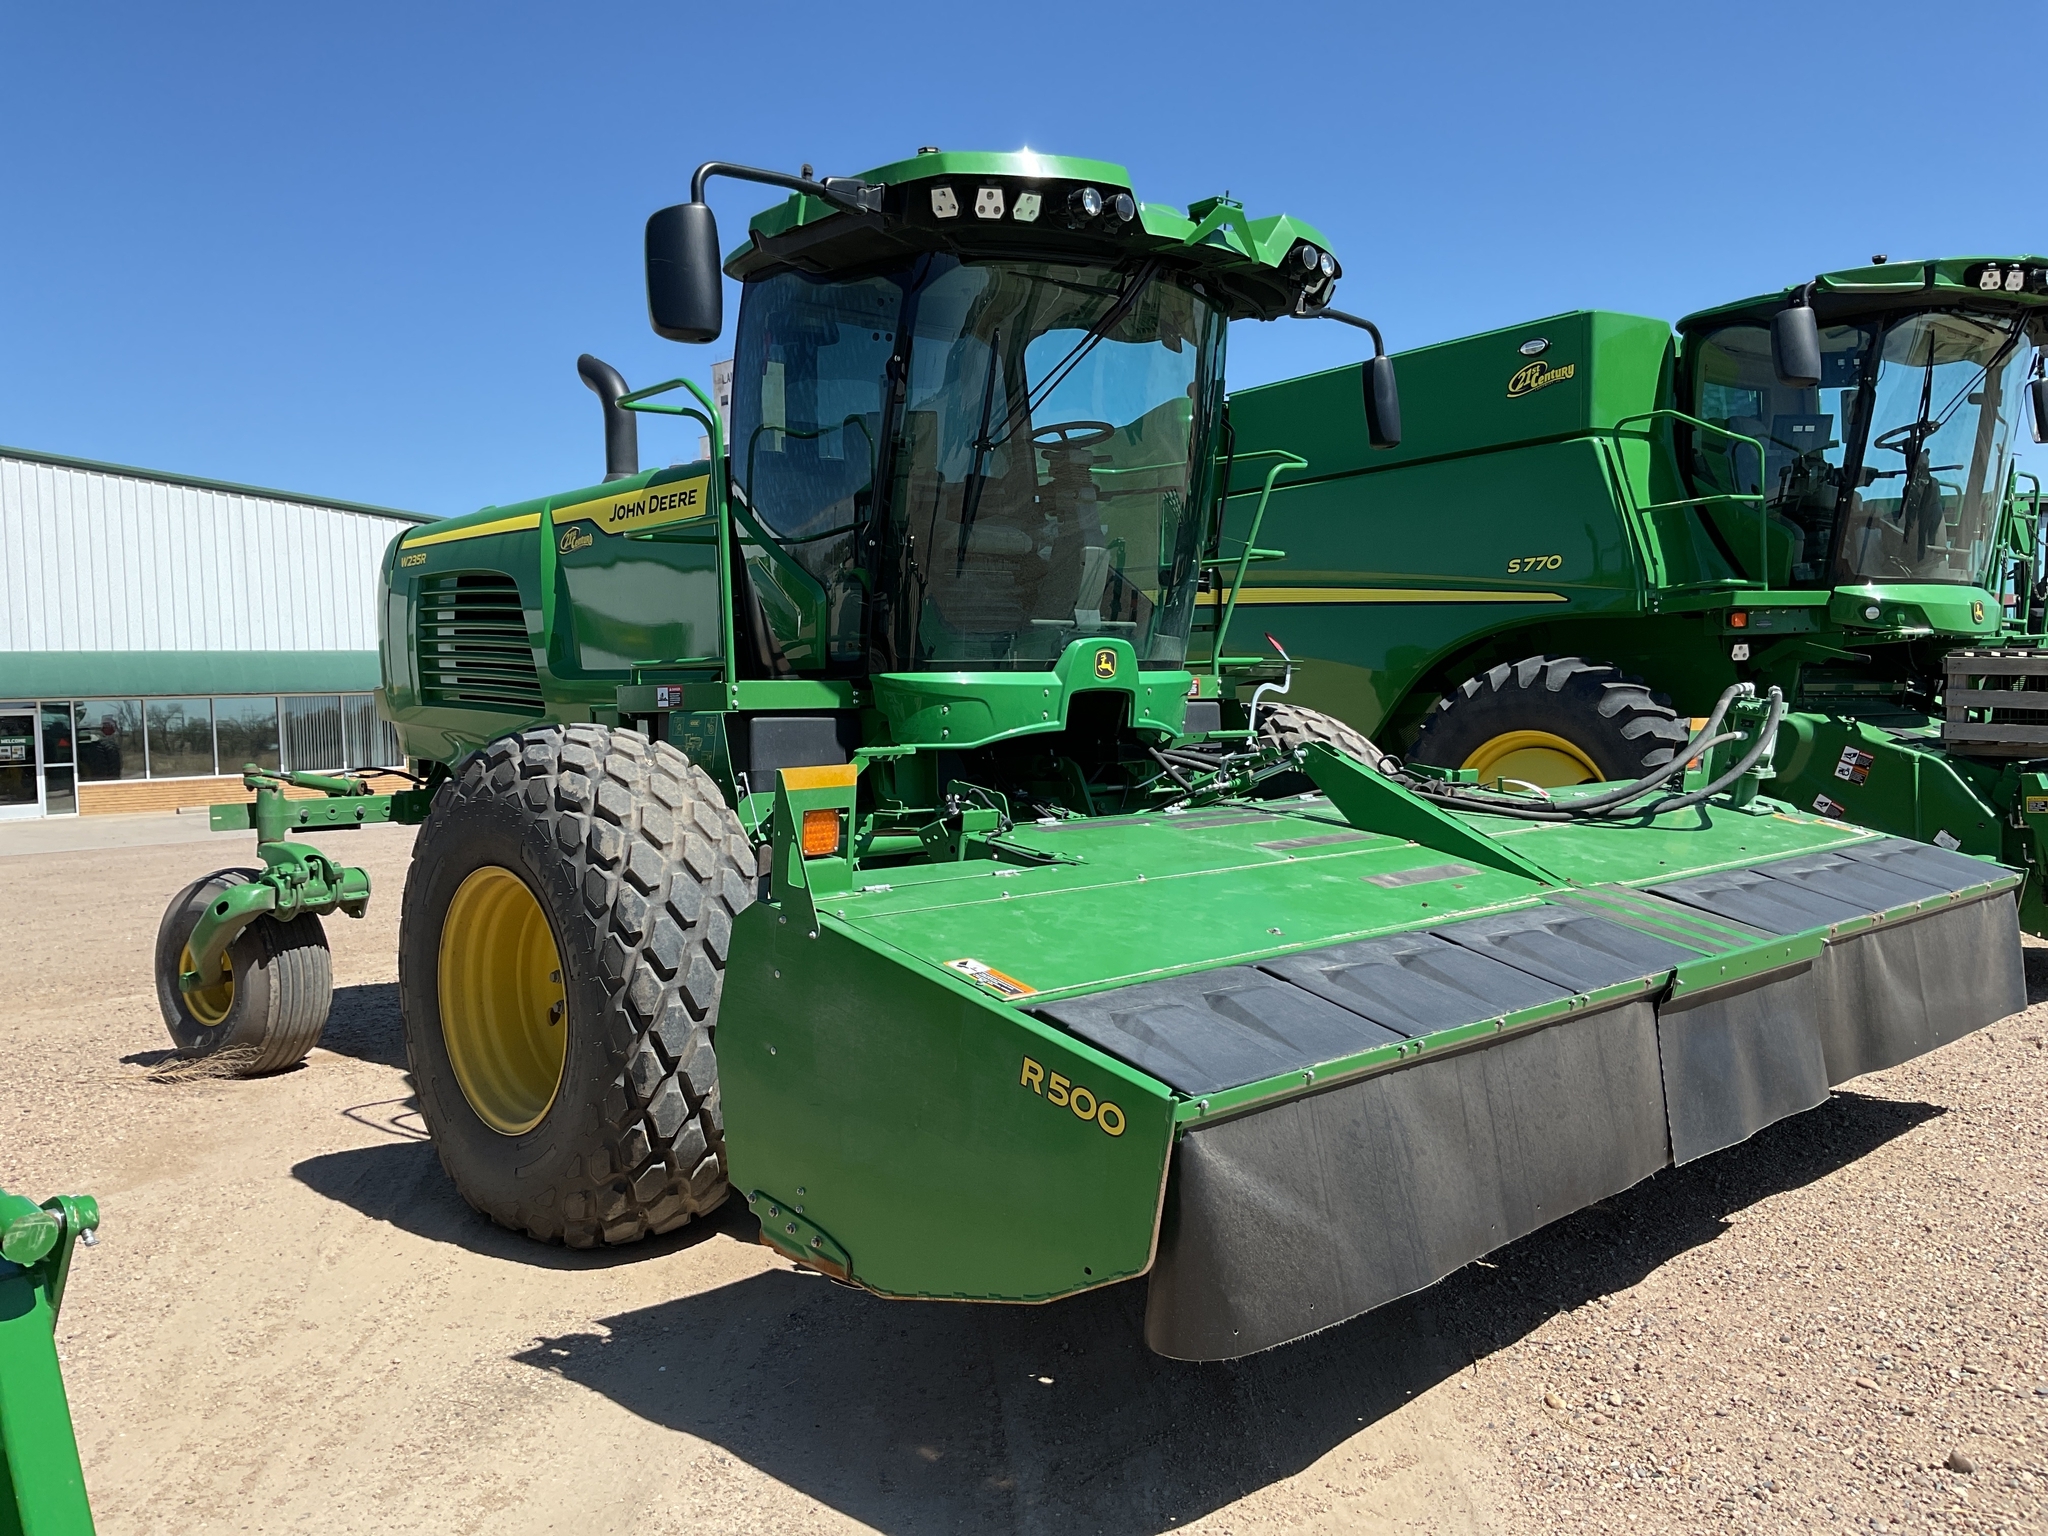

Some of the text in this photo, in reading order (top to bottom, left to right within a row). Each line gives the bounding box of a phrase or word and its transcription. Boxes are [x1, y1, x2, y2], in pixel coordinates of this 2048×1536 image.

[609, 488, 698, 522] JOHN DEERE
[401, 553, 427, 568] W235R
[1507, 554, 1562, 573] S770
[1020, 1054, 1126, 1137] R500
